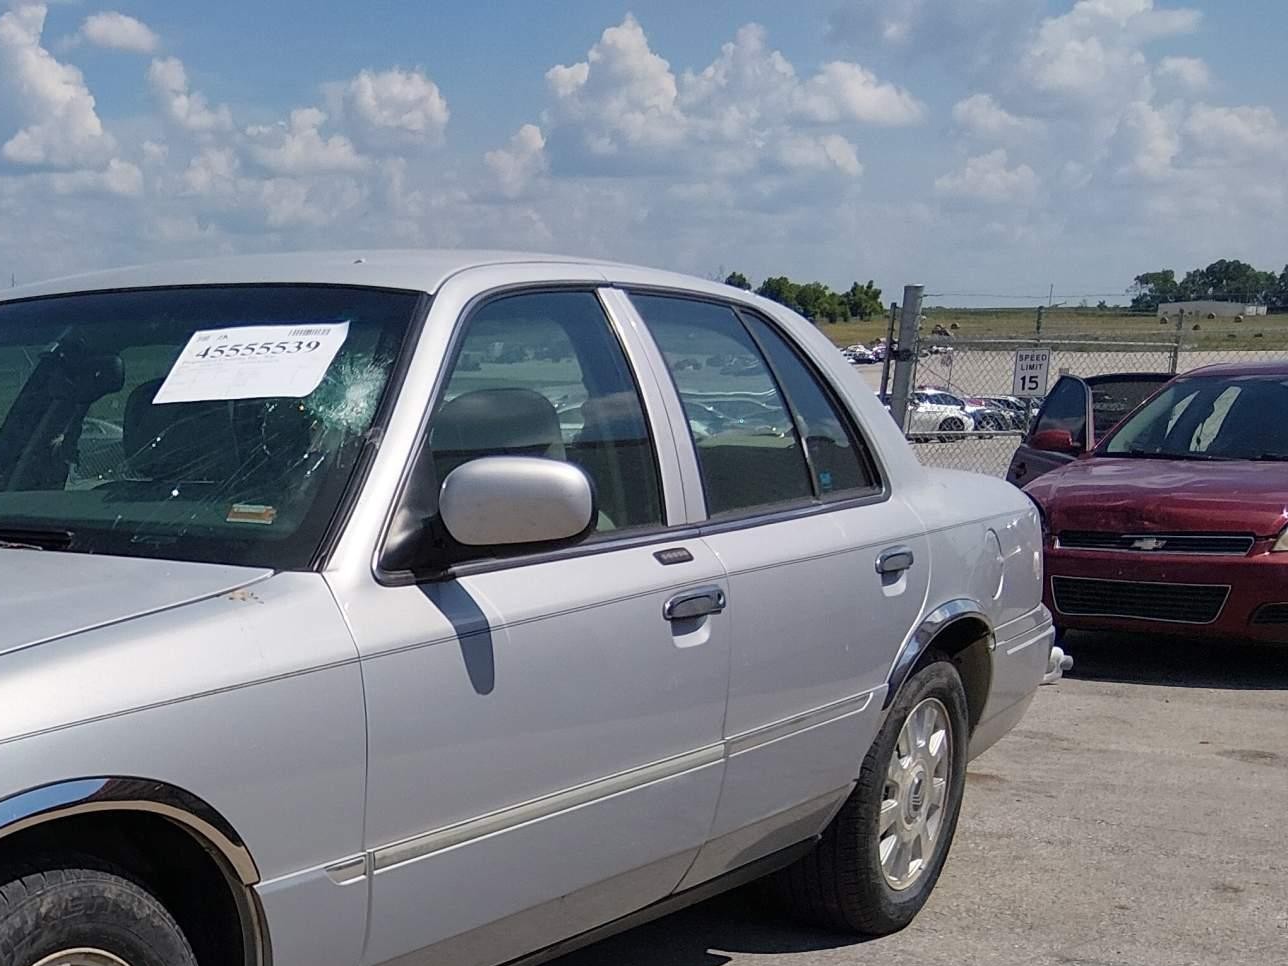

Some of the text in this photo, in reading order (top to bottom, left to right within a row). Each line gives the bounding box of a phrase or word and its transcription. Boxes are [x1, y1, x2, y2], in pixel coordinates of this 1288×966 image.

[195, 340, 321, 360] 45555539
[1019, 354, 1047, 362] SPEED
[1020, 375, 1039, 391] 15
